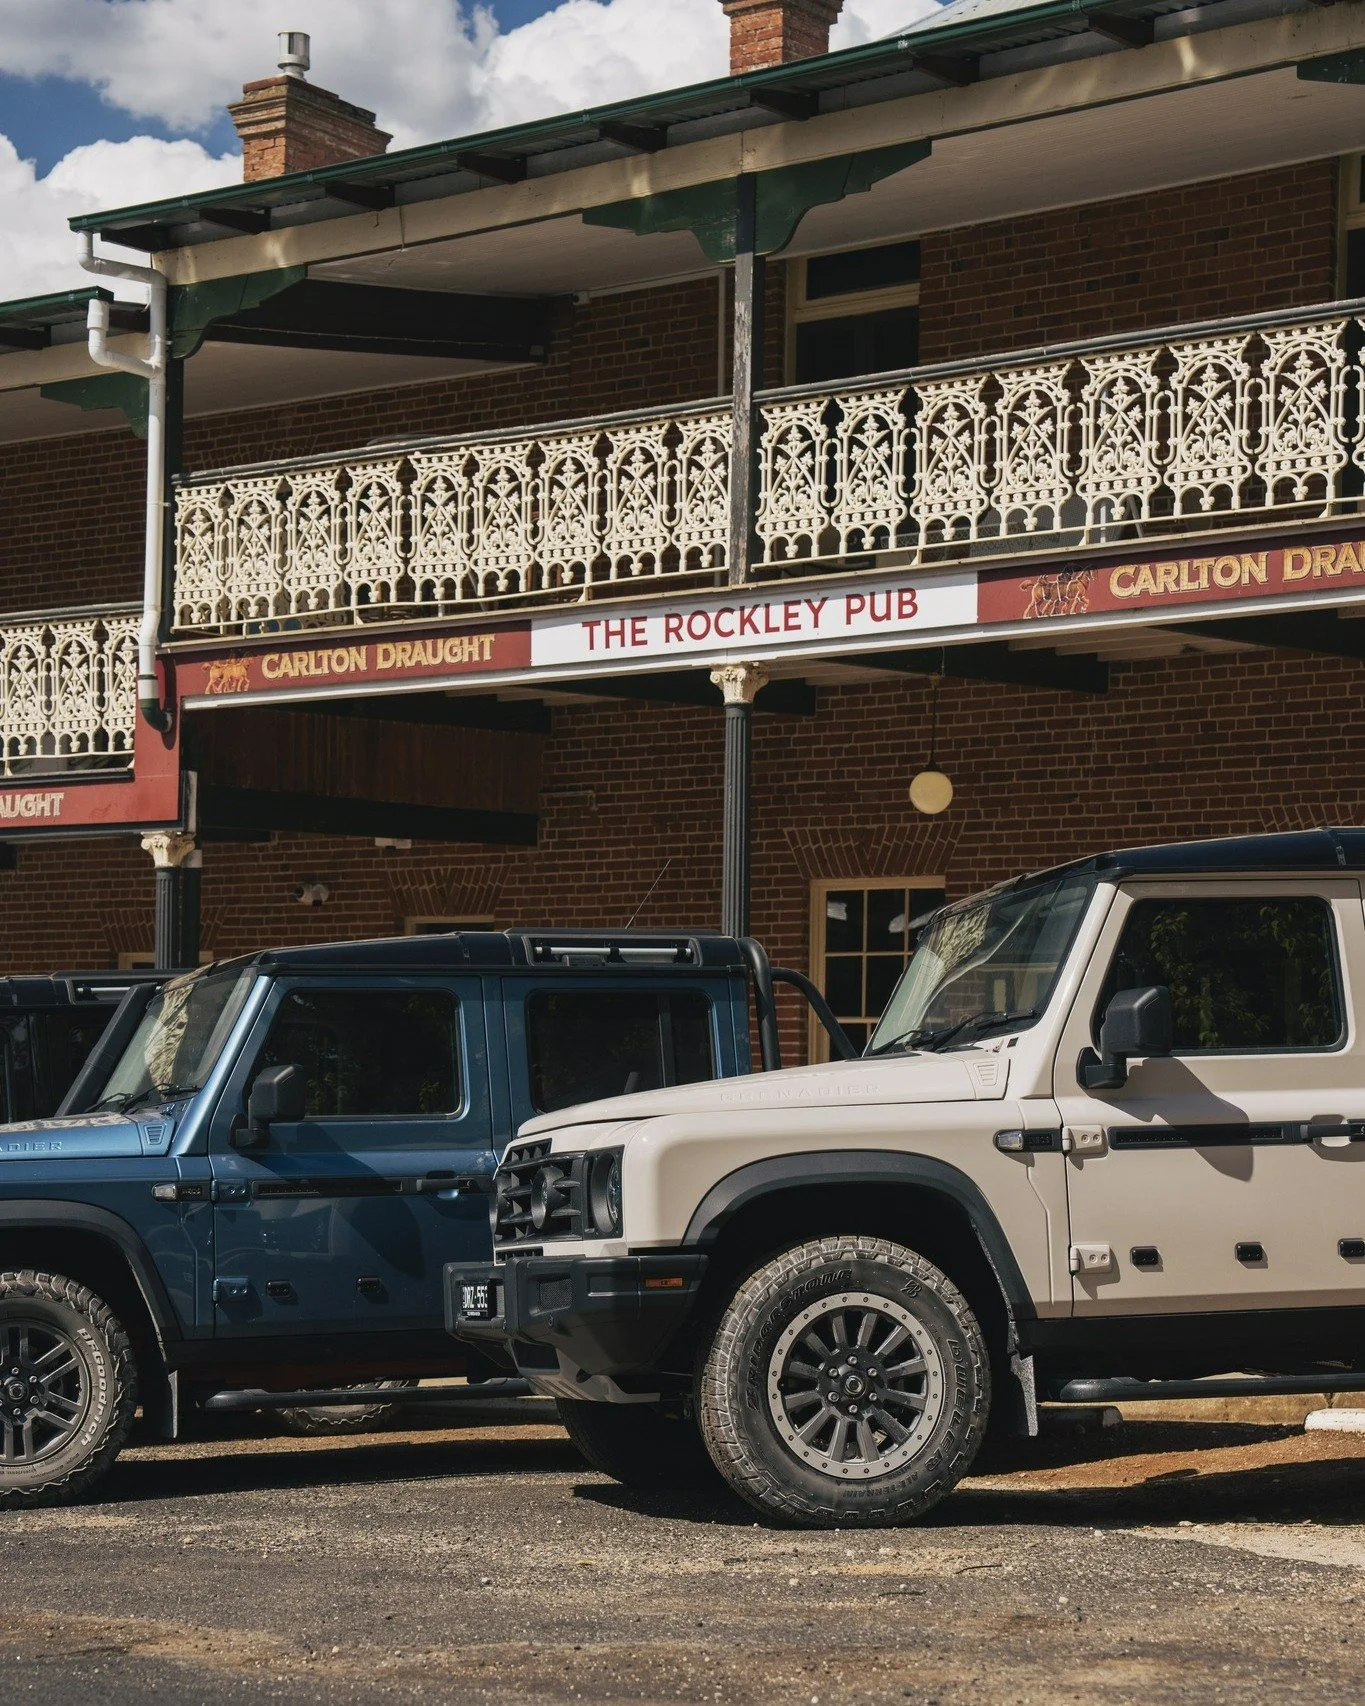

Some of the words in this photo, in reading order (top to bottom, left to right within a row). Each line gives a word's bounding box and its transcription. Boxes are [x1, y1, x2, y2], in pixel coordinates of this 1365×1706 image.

[1109, 551, 1270, 600] CARLTON
[581, 616, 648, 650] THE
[664, 596, 830, 643] ROCKLEY
[845, 587, 918, 625] PUB
[261, 645, 368, 680] CARLTON
[376, 633, 496, 671] DRAUGHT
[720, 1083, 882, 1102] GRENADIER
[746, 1268, 853, 1412] BRIDGESTONE
[76, 1327, 108, 1447] BFGoodrich
